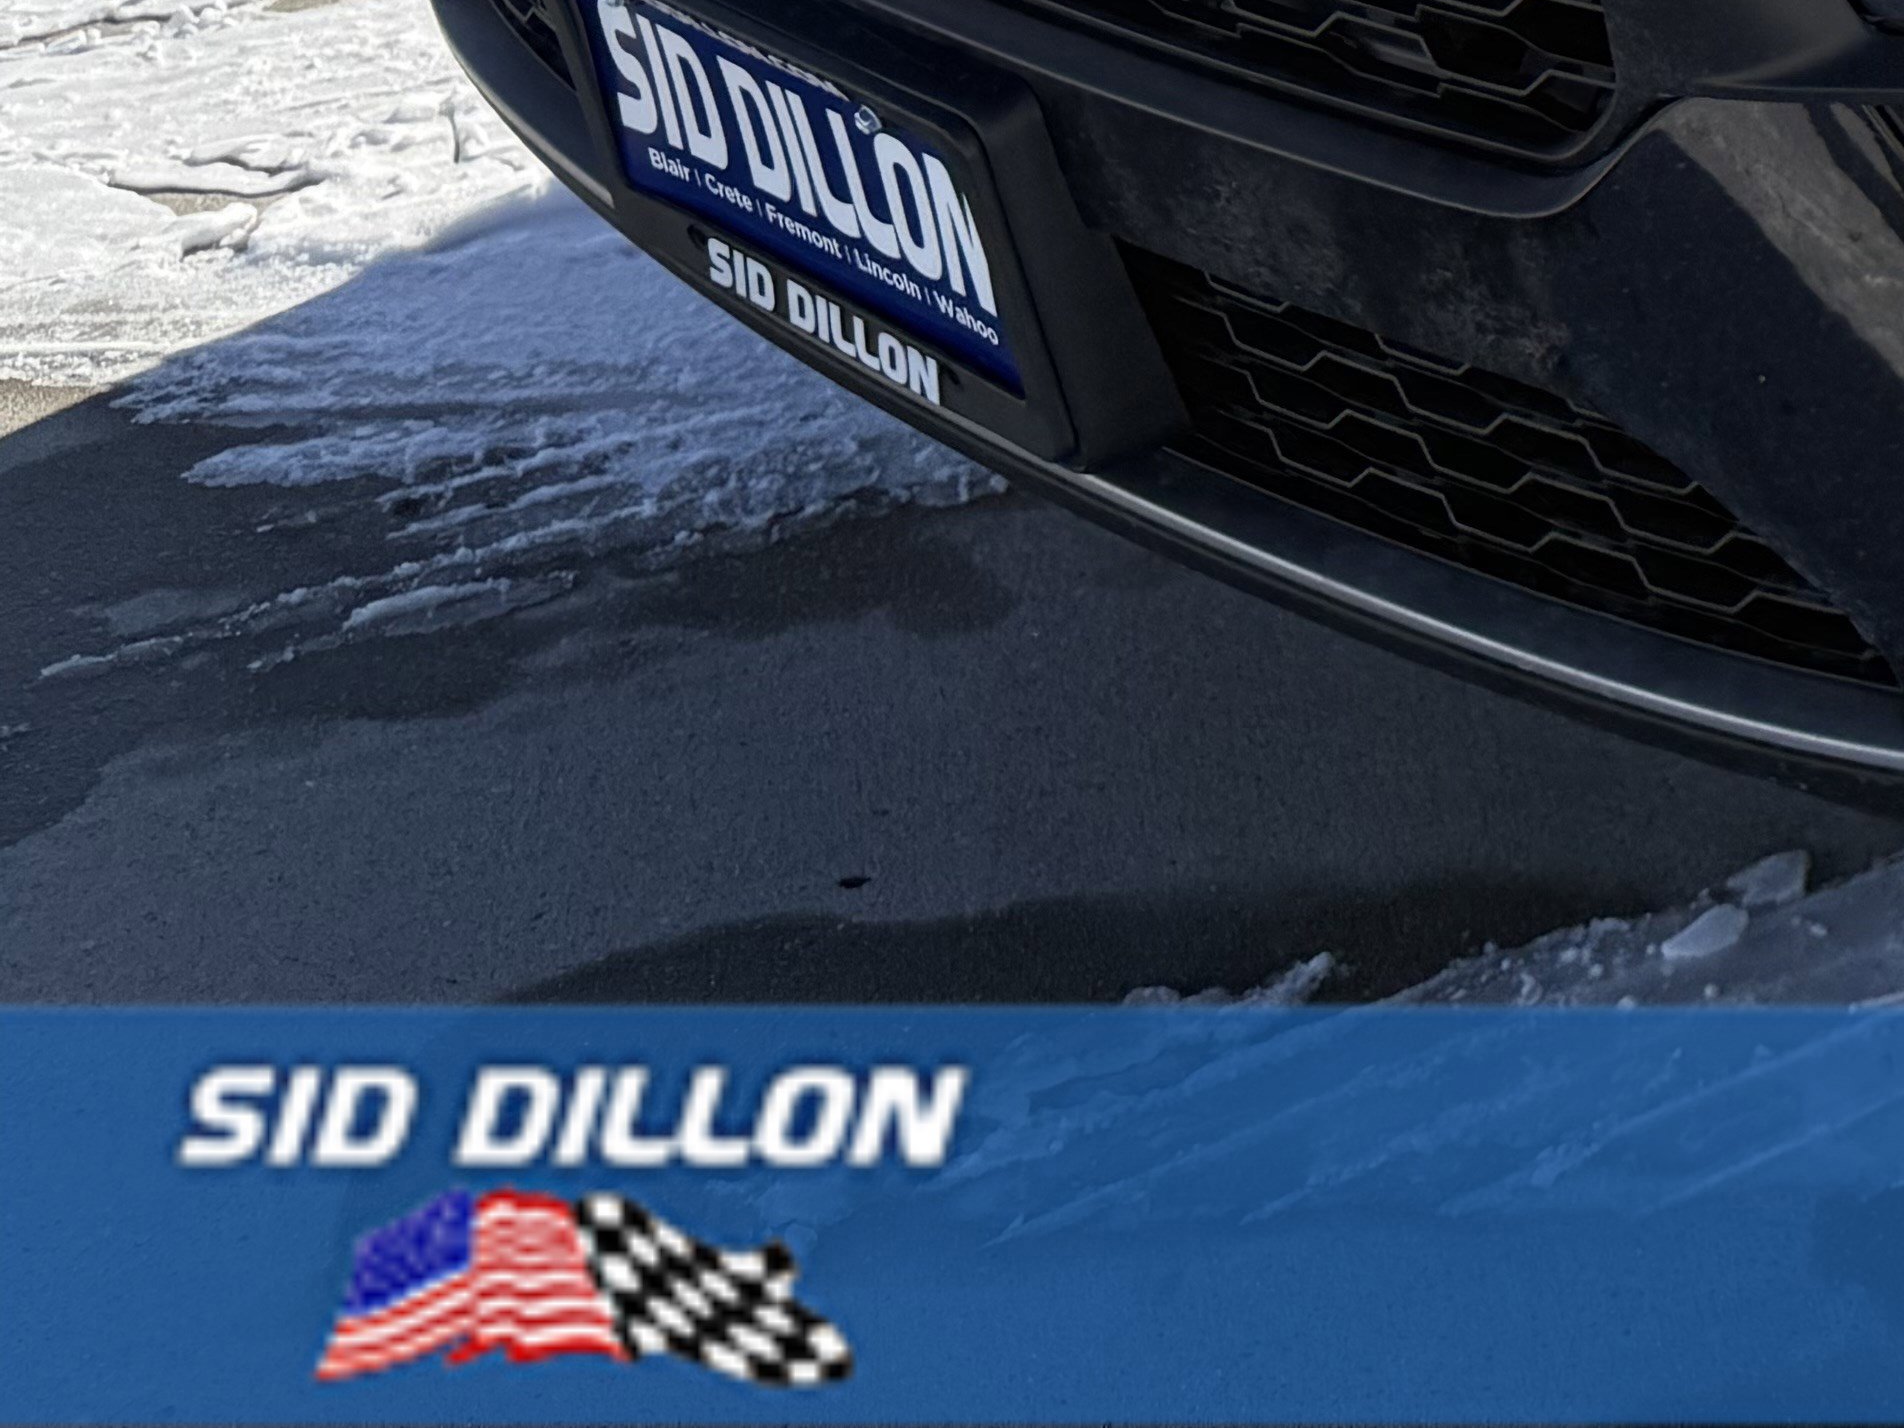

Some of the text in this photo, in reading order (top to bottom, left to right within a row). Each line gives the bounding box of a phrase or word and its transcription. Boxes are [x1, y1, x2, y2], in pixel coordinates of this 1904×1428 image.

[647, 146, 999, 346] Blair Crete Fremont Lincoln Wahoo
[717, 54, 998, 317] DILLON
[706, 236, 941, 406] SID DILLON
